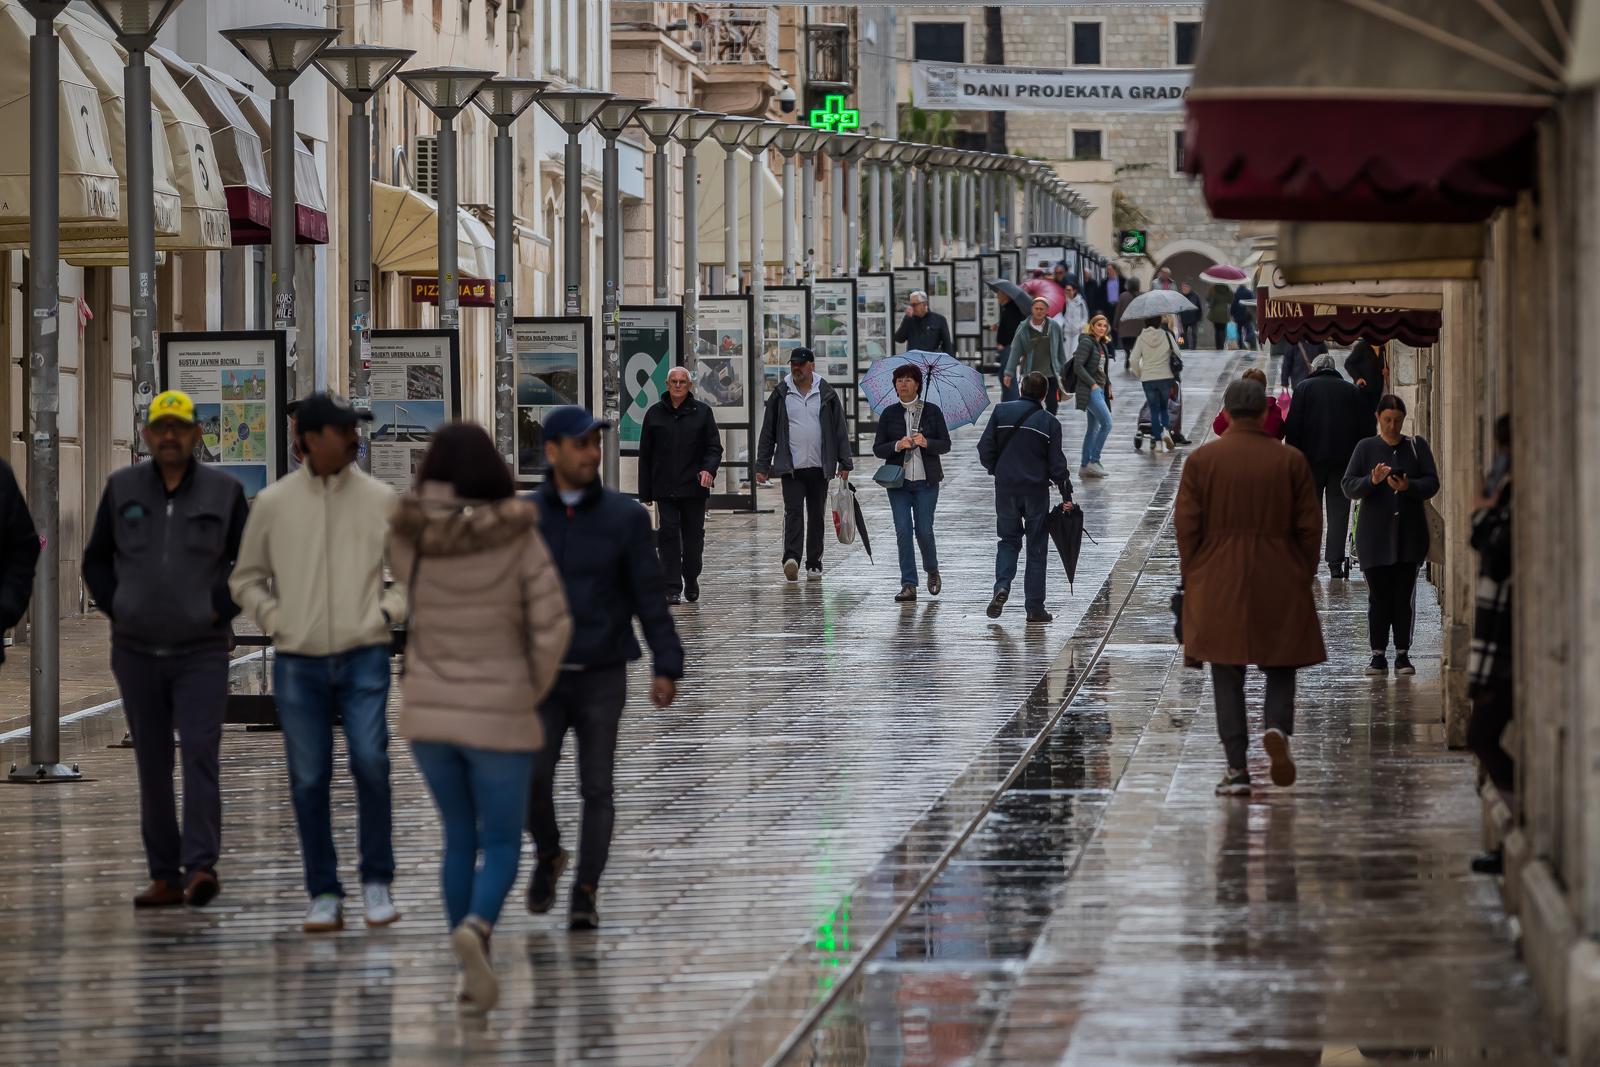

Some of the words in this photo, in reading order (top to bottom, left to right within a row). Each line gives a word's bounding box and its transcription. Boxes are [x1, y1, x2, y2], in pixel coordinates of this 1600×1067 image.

[963, 83, 1009, 97] DANI
[1015, 84, 1123, 99] PROJEKATA
[1265, 299, 1304, 318] KRUNA
[178, 358, 198, 366] SUSTAV
